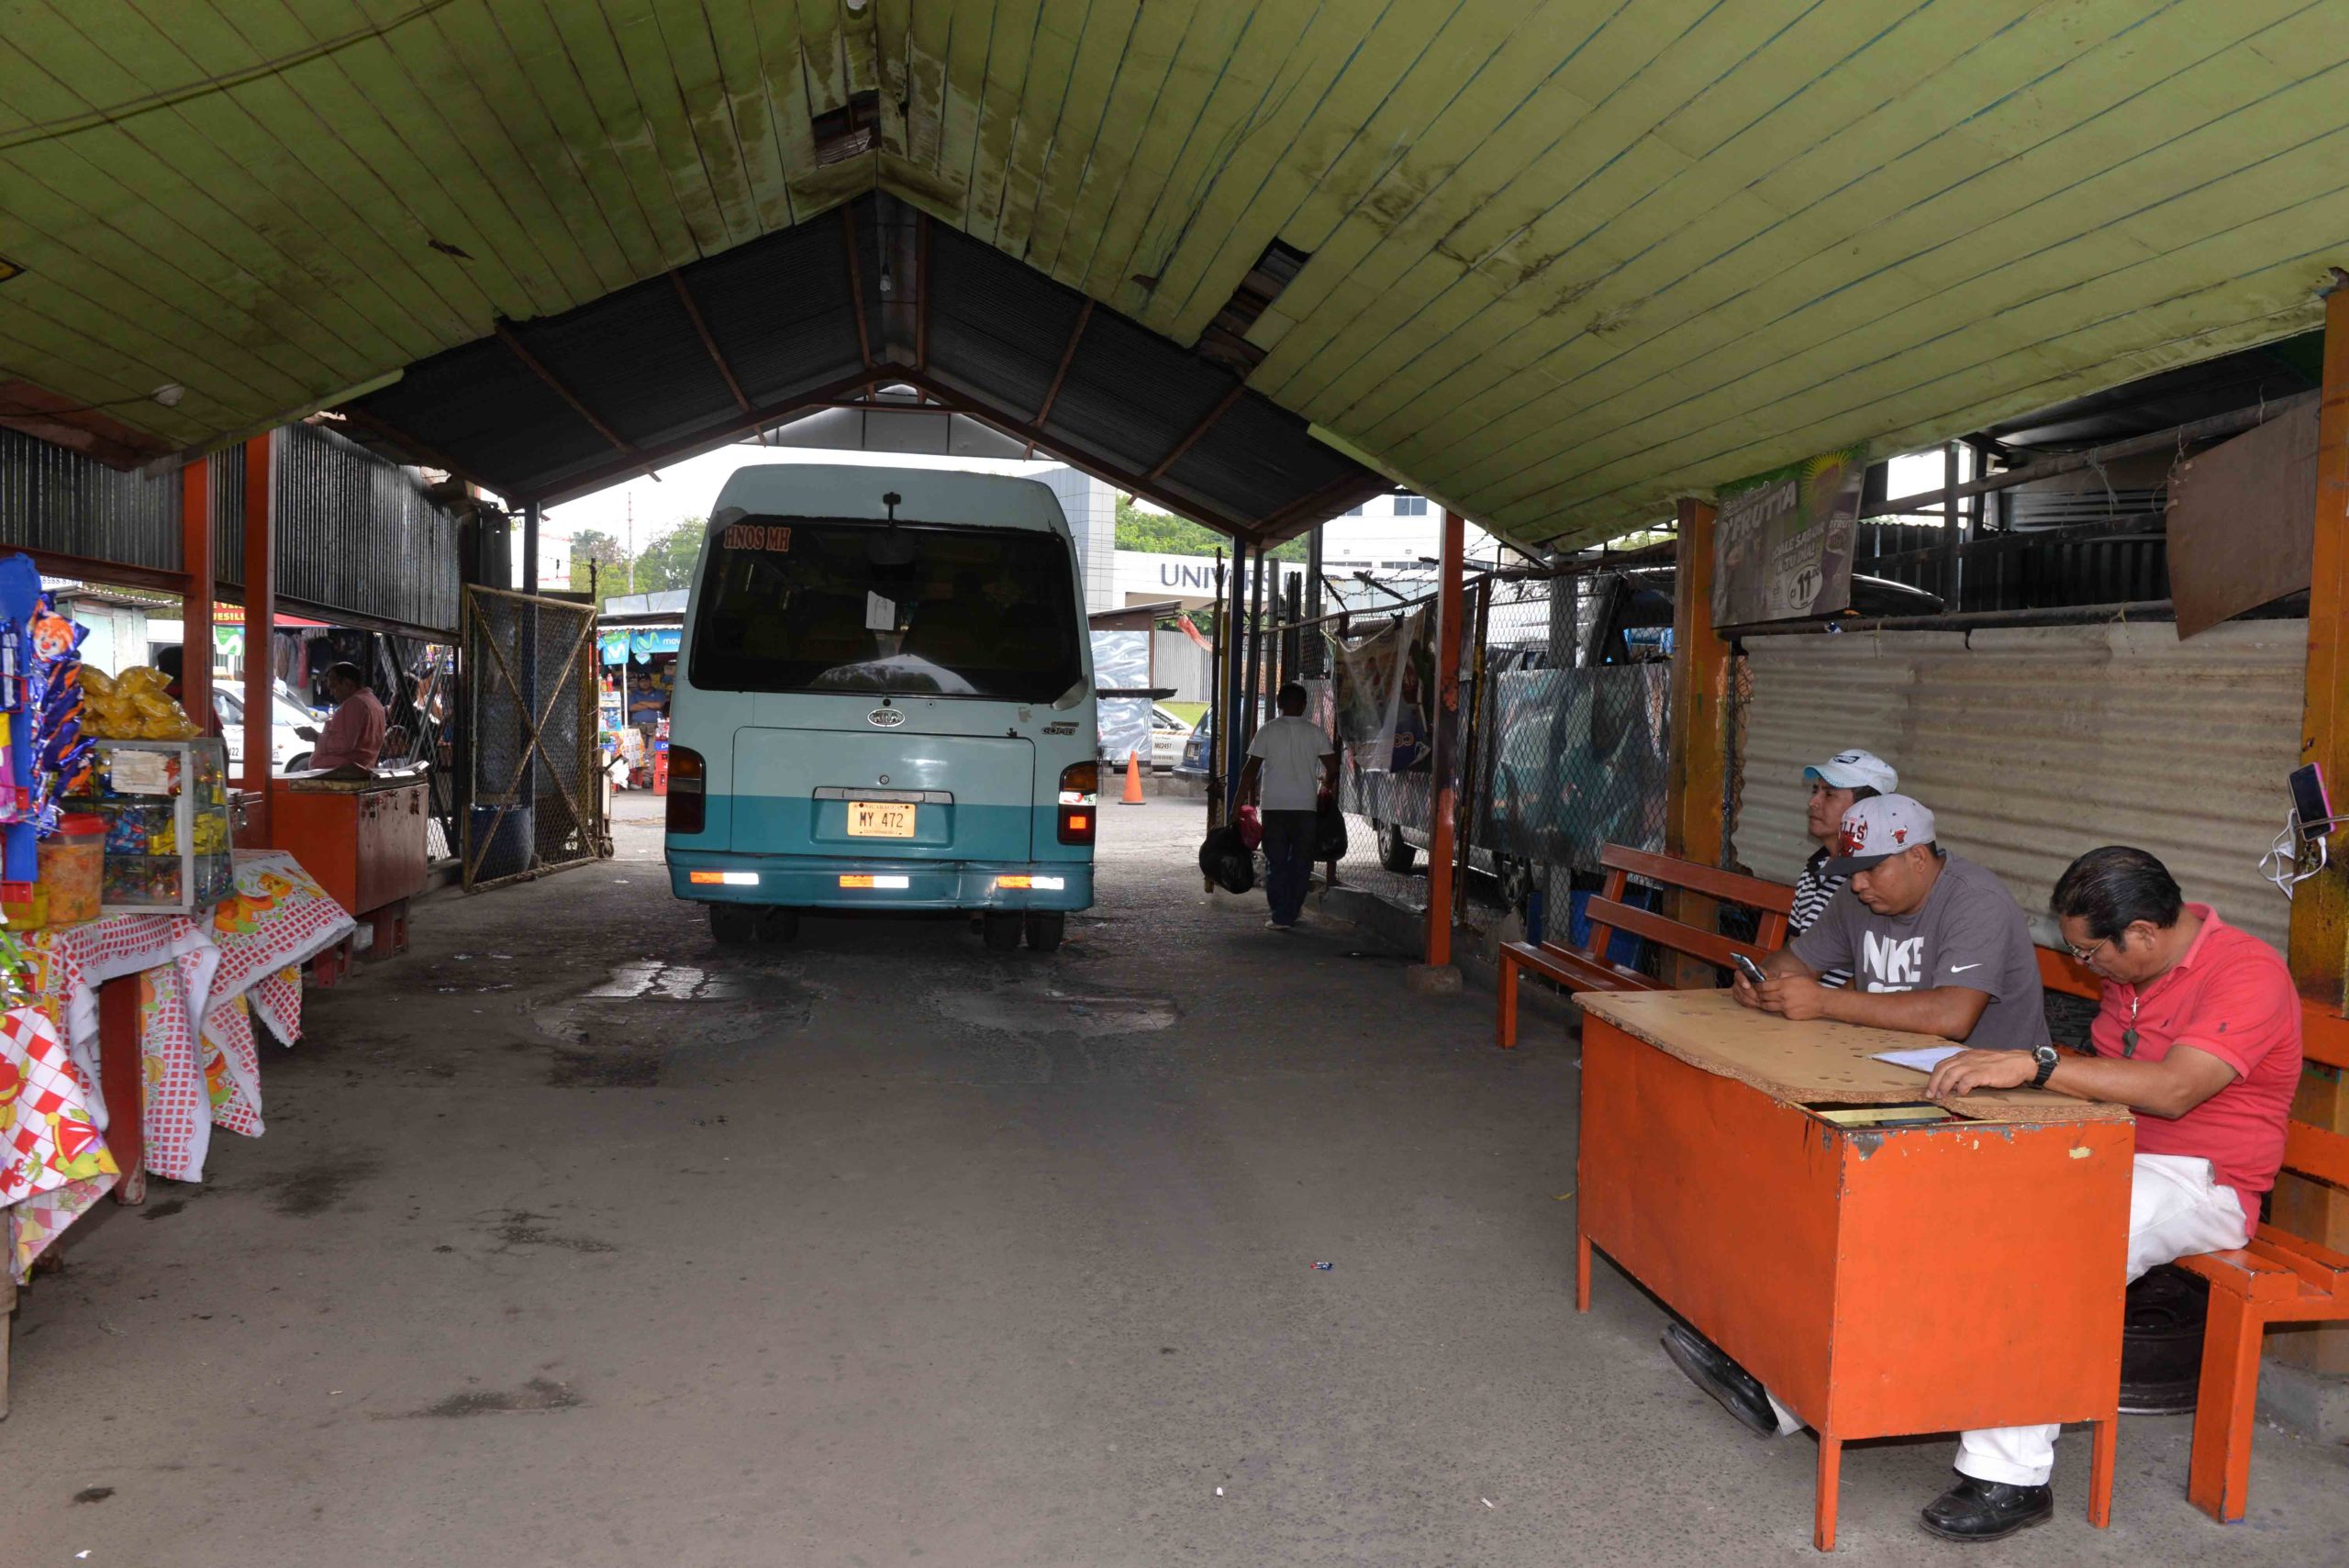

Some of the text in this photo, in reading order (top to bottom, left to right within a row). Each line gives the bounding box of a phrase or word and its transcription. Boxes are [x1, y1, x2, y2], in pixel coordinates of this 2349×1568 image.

[723, 524, 791, 551] HNOS MH
[873, 712, 901, 723] KIA
[859, 812, 904, 828] MY 472
[1863, 929, 1924, 983] NIKE
